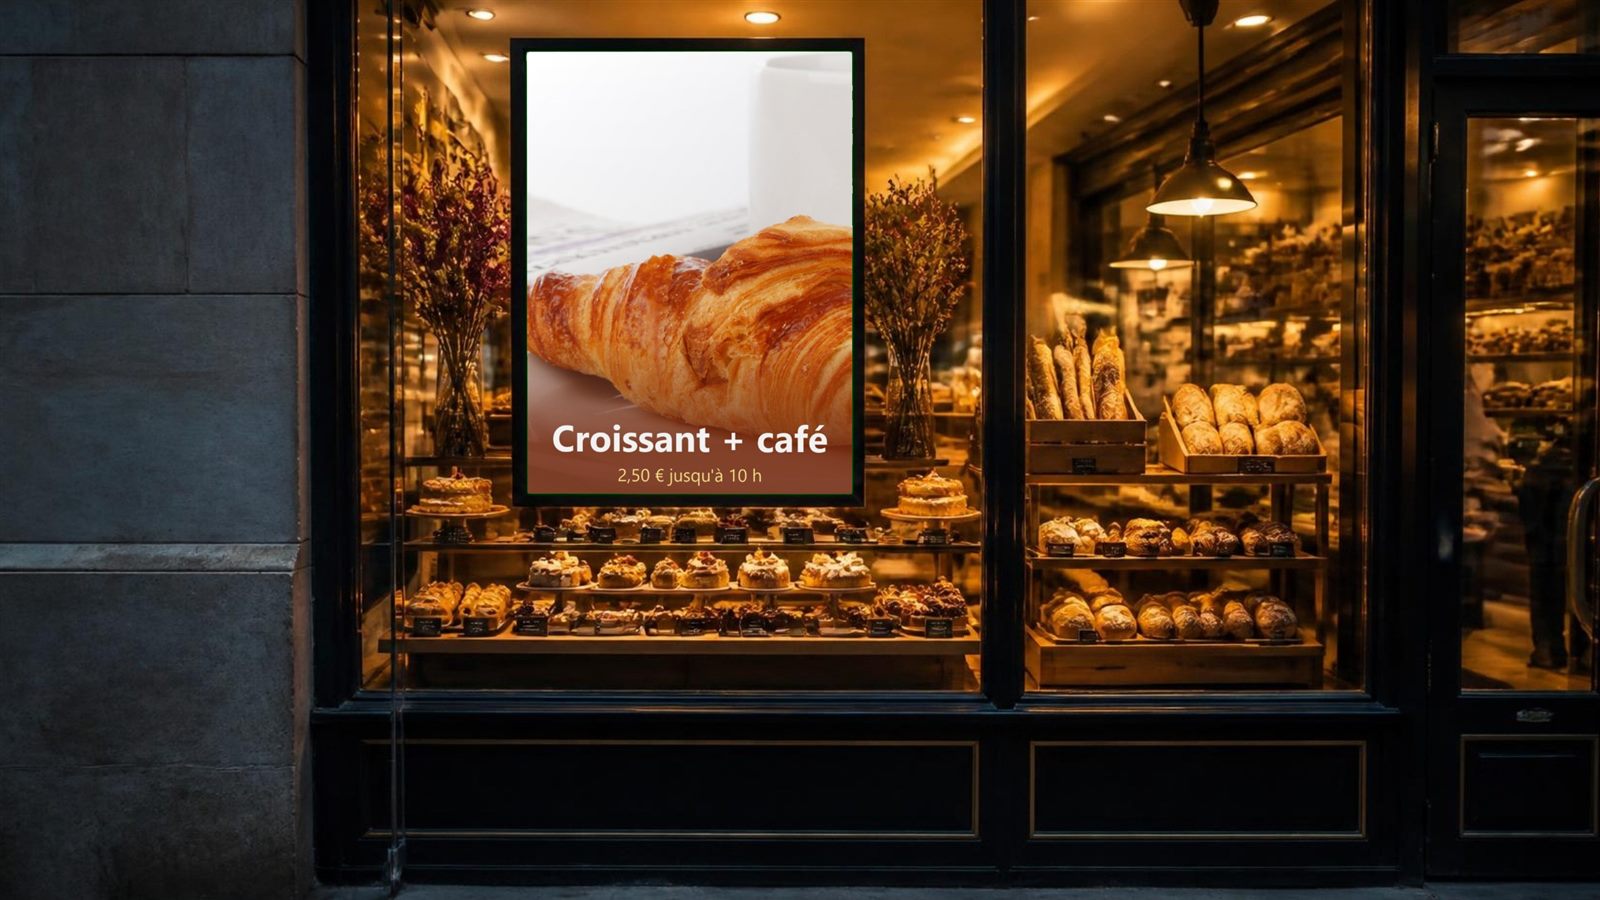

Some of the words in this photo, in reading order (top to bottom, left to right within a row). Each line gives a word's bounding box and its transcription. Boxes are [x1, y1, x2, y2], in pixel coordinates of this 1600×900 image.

[552, 423, 710, 453] Croissant
[724, 432, 743, 451] +
[757, 423, 828, 454] café
[617, 468, 650, 485] 2,50
[655, 468, 665, 483] €
[667, 467, 724, 487] jusqu'à
[729, 468, 748, 483] 10
[752, 468, 762, 483] h
